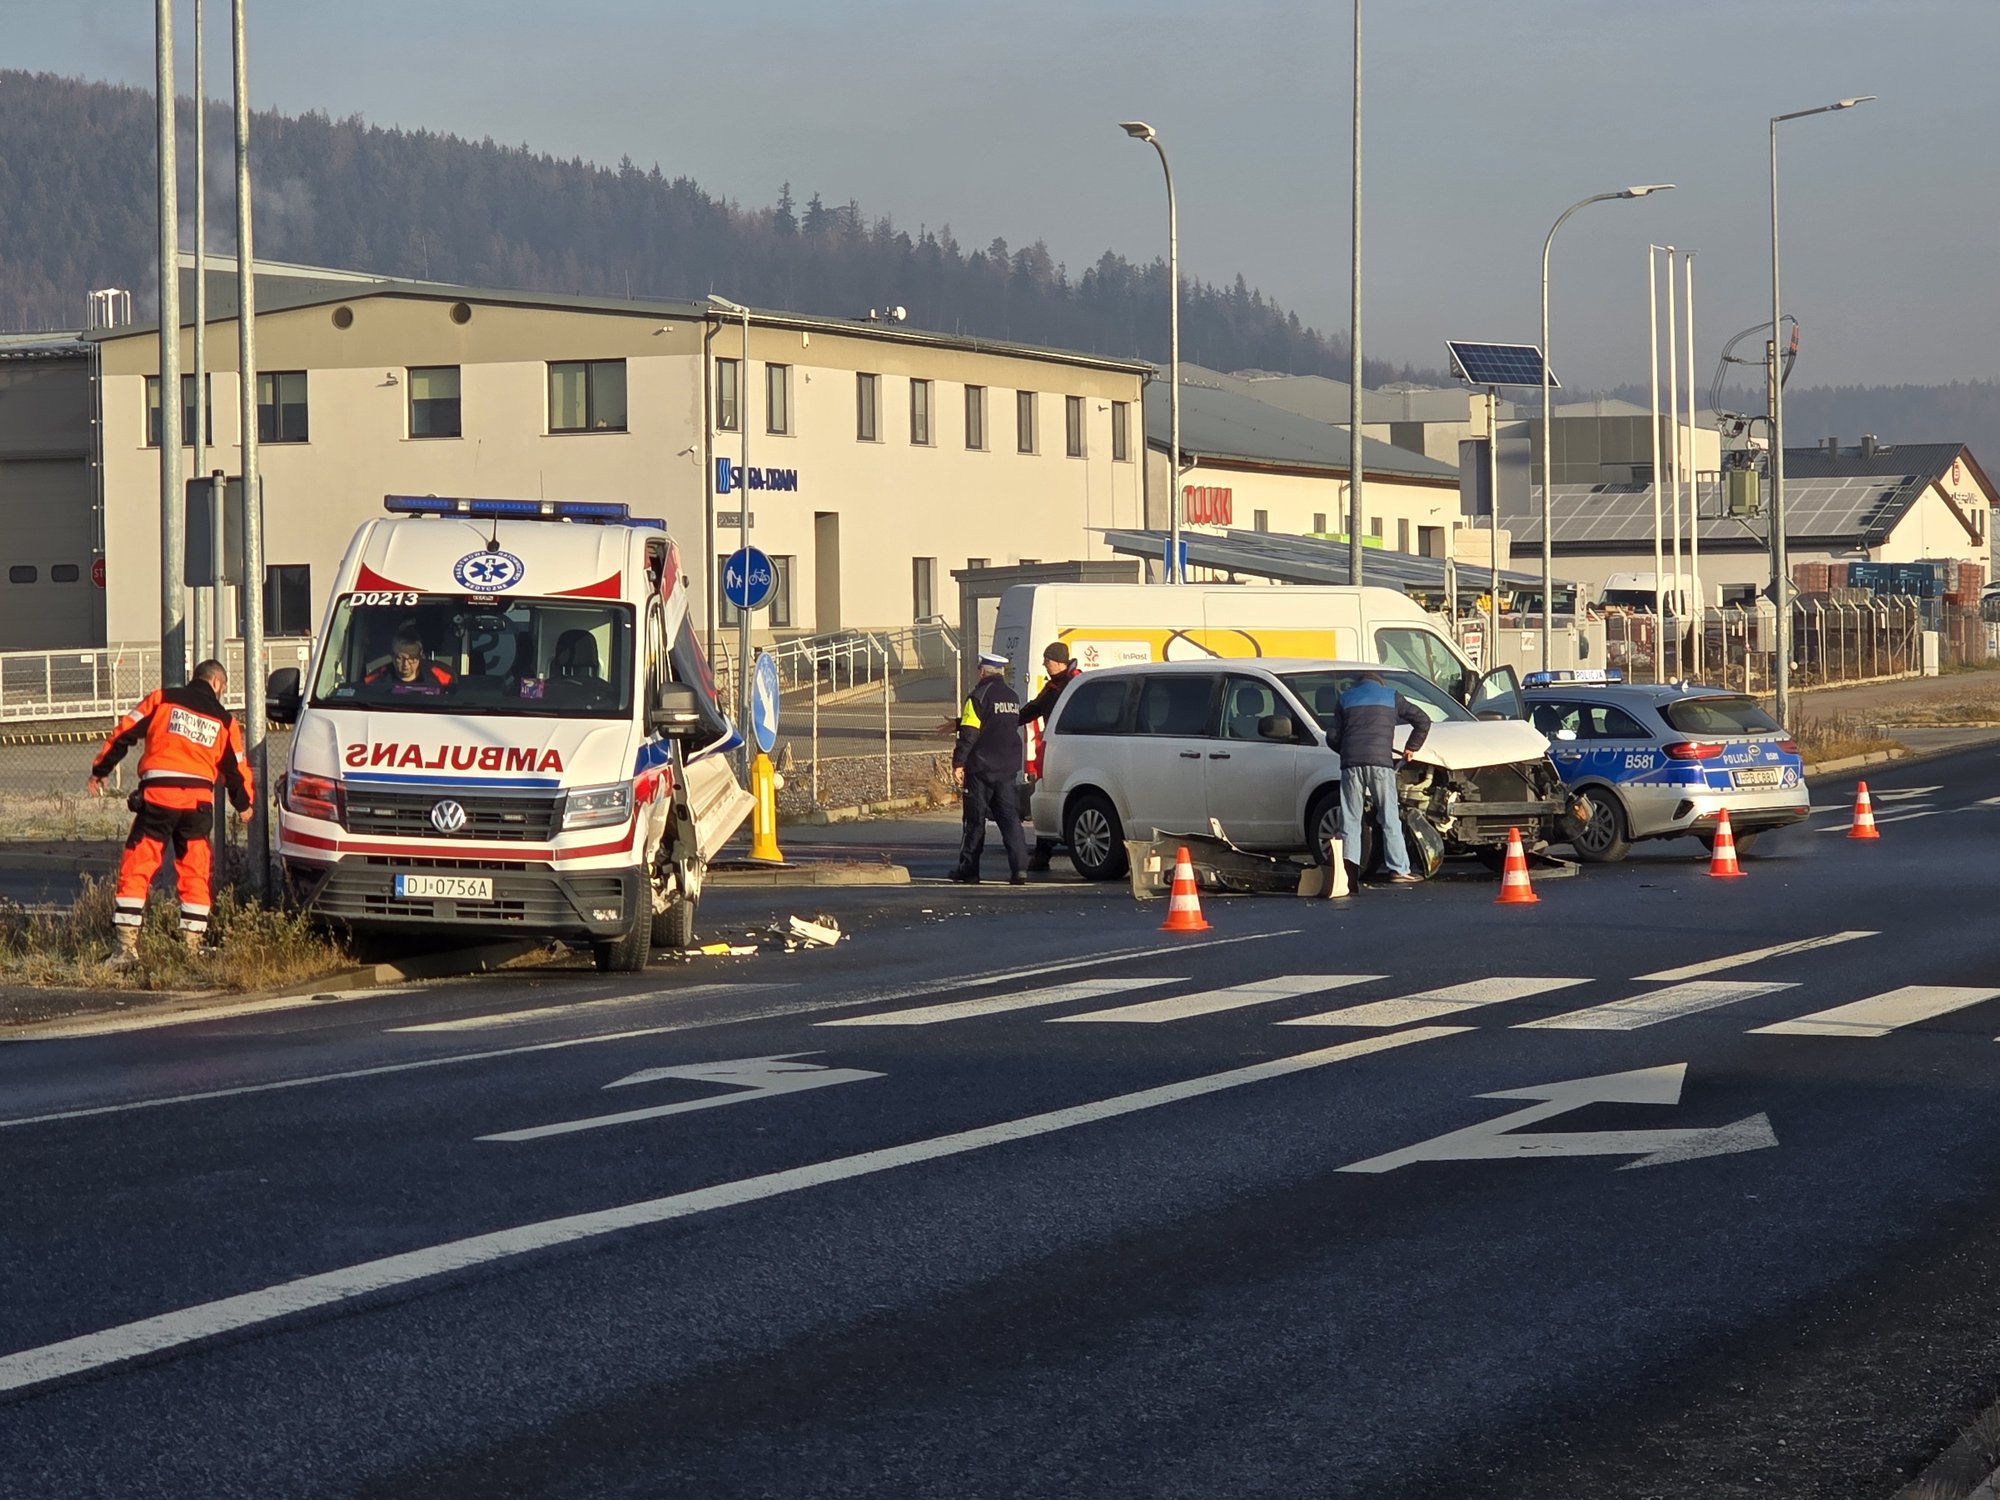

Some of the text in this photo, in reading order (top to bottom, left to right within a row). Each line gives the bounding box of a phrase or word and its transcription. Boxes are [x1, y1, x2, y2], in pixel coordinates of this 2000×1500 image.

[730, 466, 797, 492] SRA-DRAIN
[94, 568, 104, 578] ST
[464, 582, 508, 591] MEDYCZNE
[349, 592, 418, 607] D0213
[1576, 671, 1603, 680] POLICJA
[1625, 754, 1655, 769] B581
[1723, 753, 1754, 765] POLICJA
[407, 878, 428, 894] DJ
[436, 879, 488, 897] 0756A
